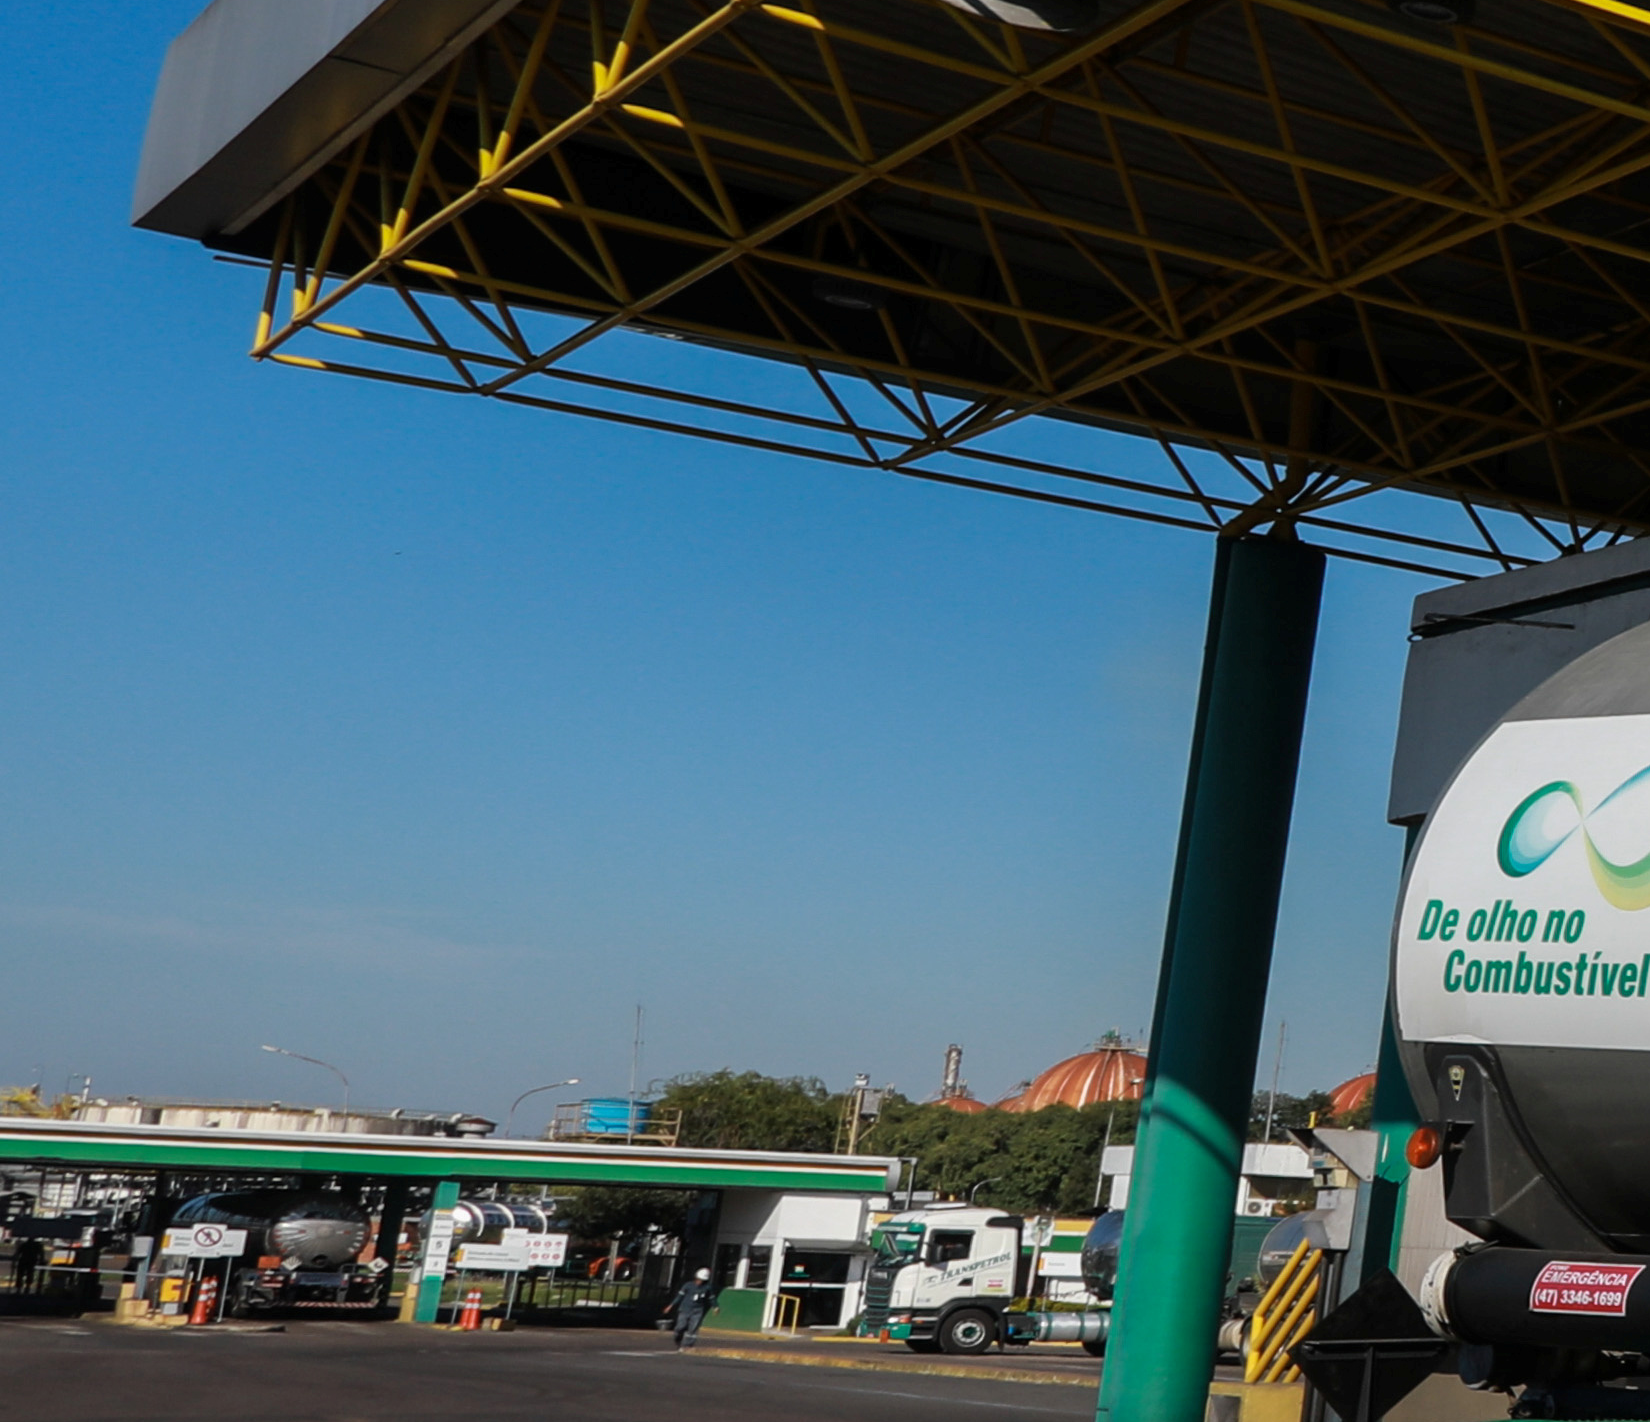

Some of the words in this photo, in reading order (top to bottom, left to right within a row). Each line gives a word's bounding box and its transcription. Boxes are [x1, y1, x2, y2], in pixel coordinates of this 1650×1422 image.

[1417, 899, 1460, 941] De
[1466, 899, 1538, 943] olho
[1541, 909, 1586, 944] no
[940, 1252, 1012, 1281] TRANSPETROL
[1541, 1270, 1628, 1286] EMERGÊNCIA
[1535, 1288, 1558, 1306] (47)
[1560, 1290, 1622, 1306] 3346-1699
